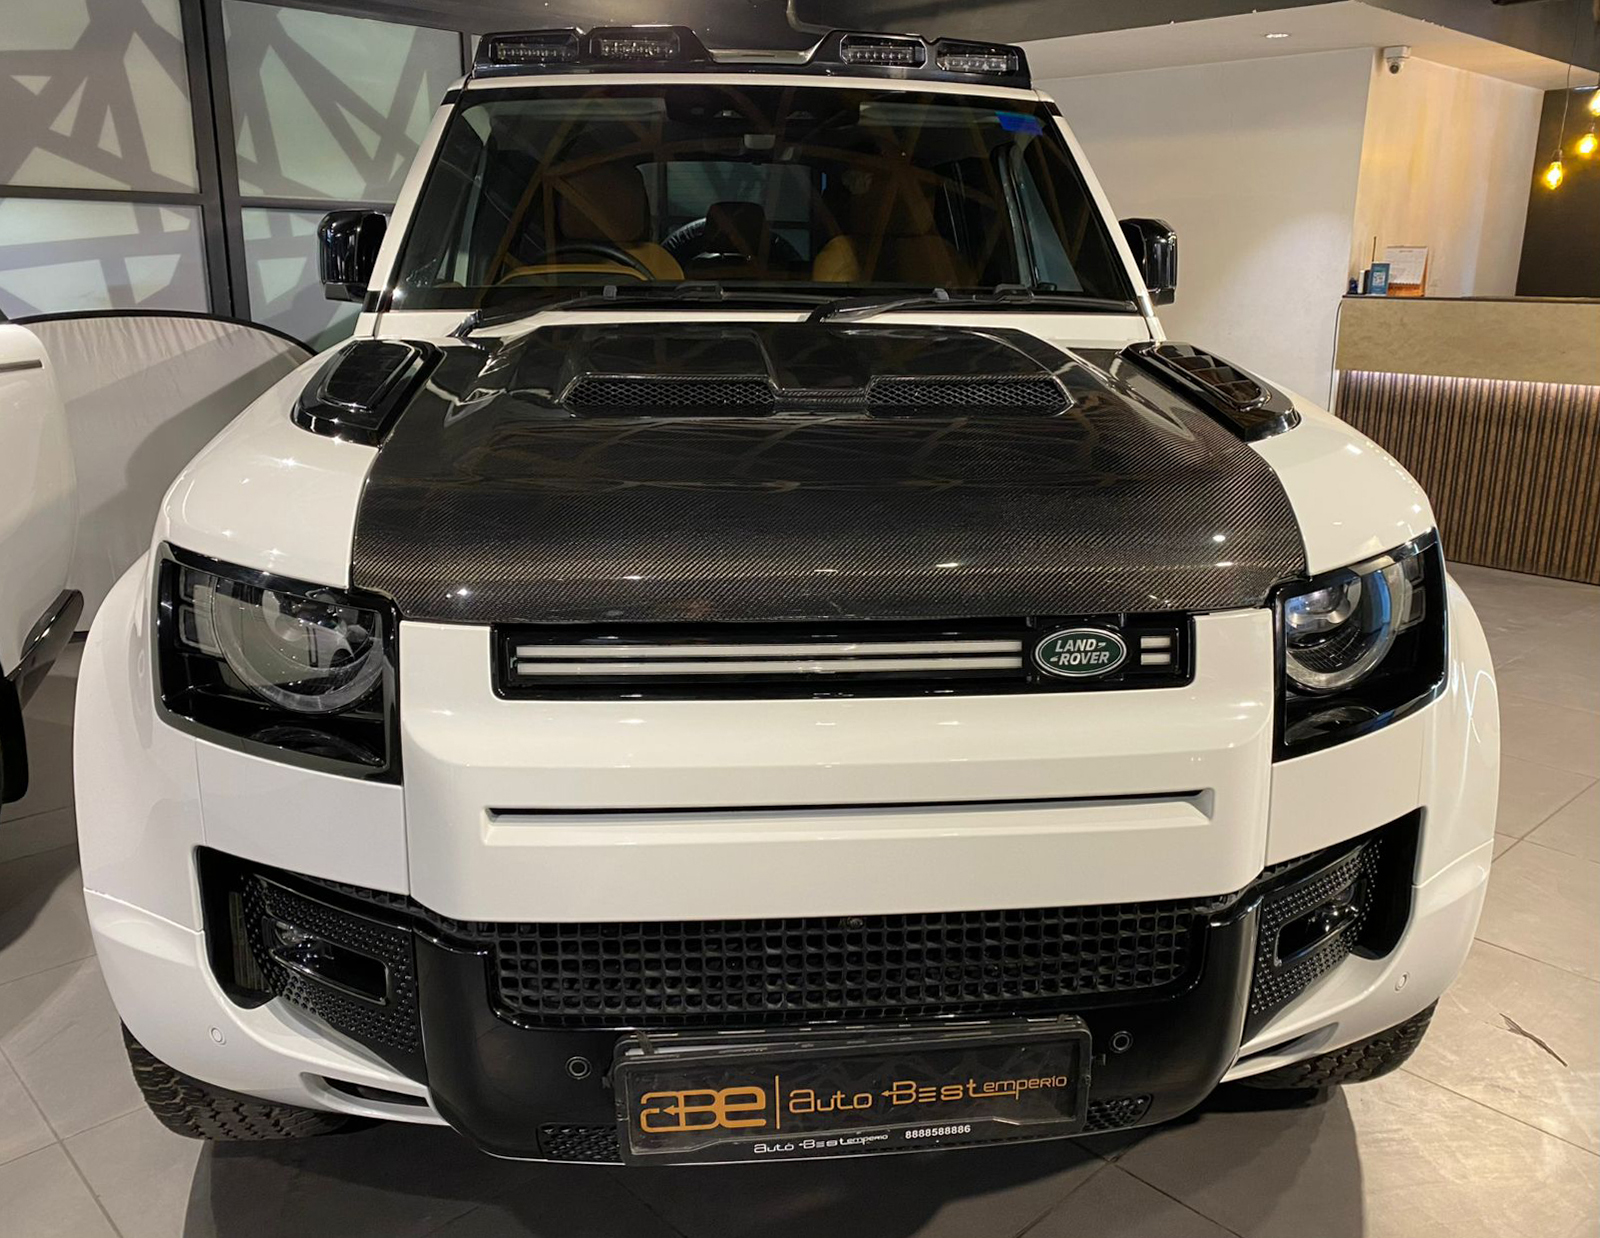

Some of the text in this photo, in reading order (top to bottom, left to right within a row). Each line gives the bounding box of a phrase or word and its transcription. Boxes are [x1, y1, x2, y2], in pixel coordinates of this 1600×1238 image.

[1055, 638, 1097, 653] LAND
[1058, 651, 1110, 666] ROVER
[904, 1124, 971, 1140] 8888588886
